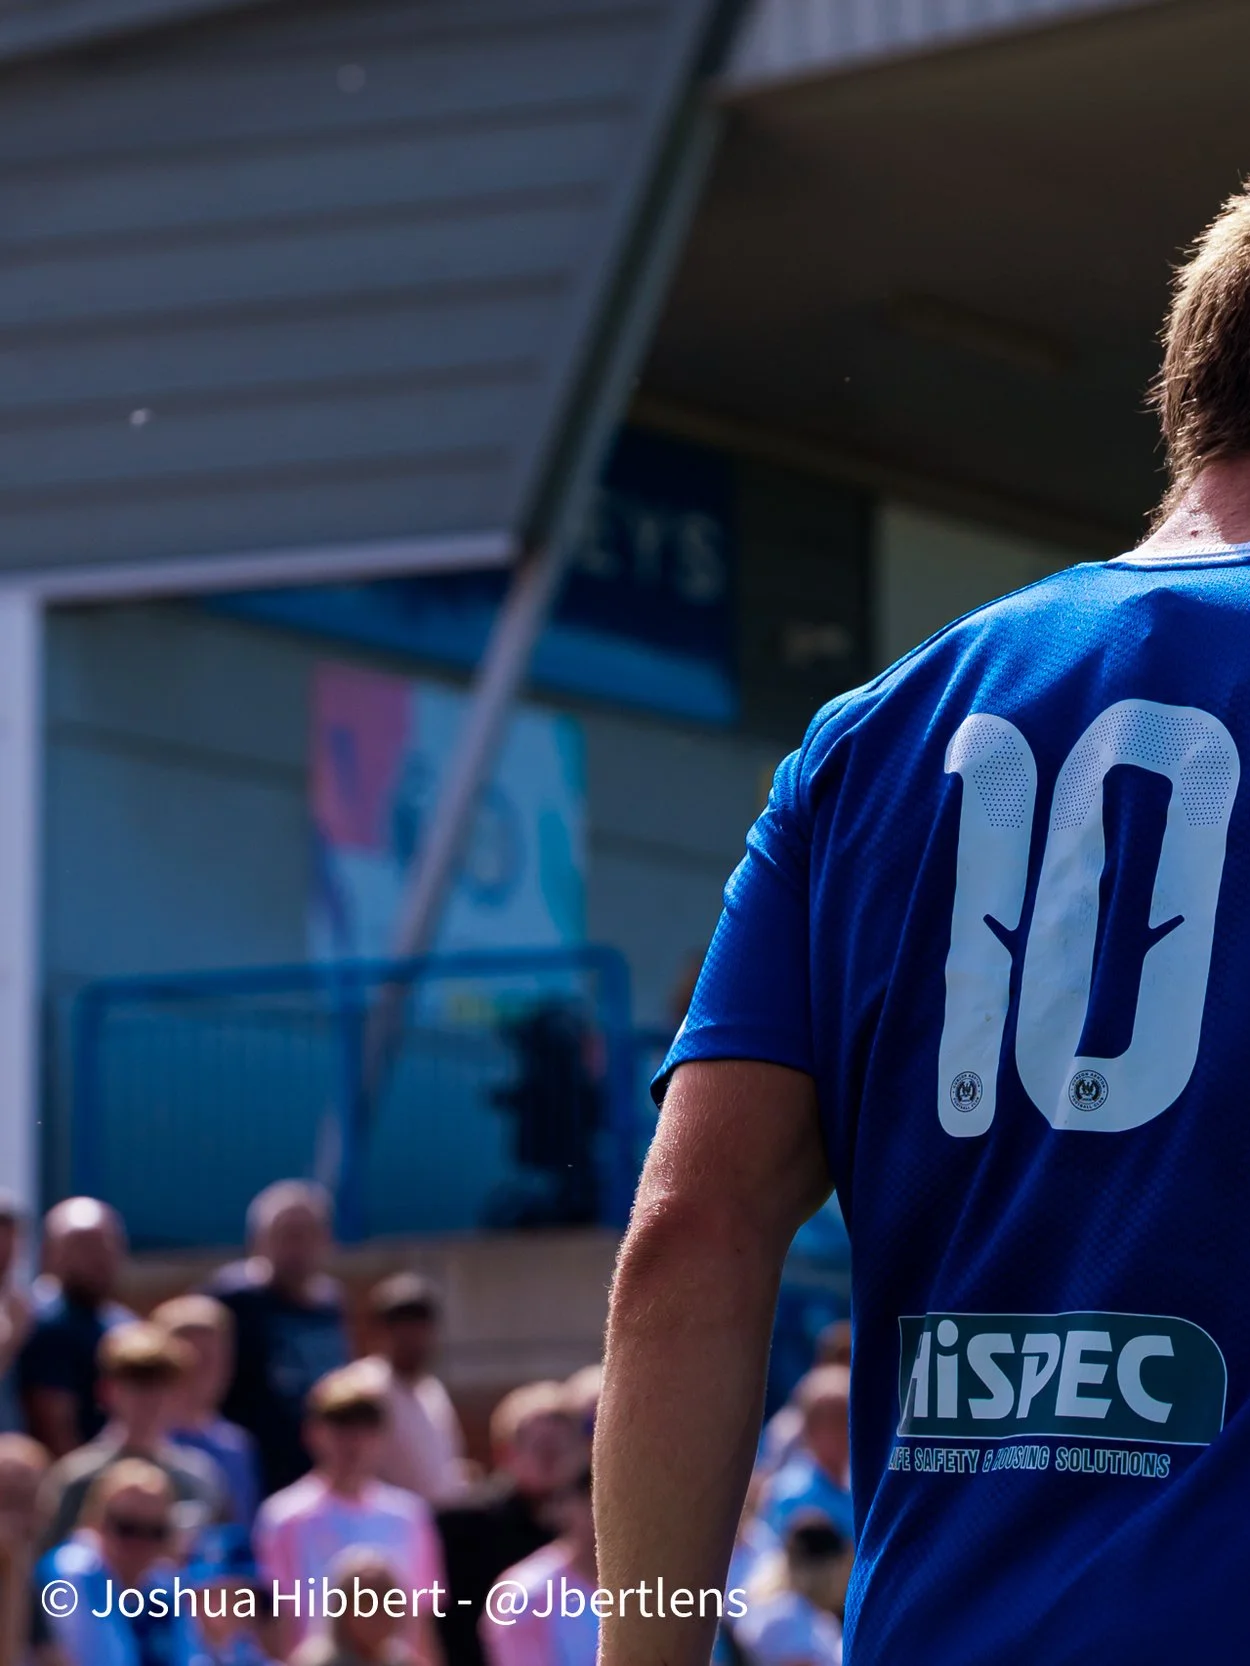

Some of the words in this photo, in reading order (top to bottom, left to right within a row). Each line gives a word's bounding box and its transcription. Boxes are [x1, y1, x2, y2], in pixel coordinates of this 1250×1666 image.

[938, 699, 1240, 1138] 10
[914, 1447, 981, 1473] SAFETY
[981, 1449, 994, 1472] &
[1055, 1447, 1170, 1478] SOLUTIONS
